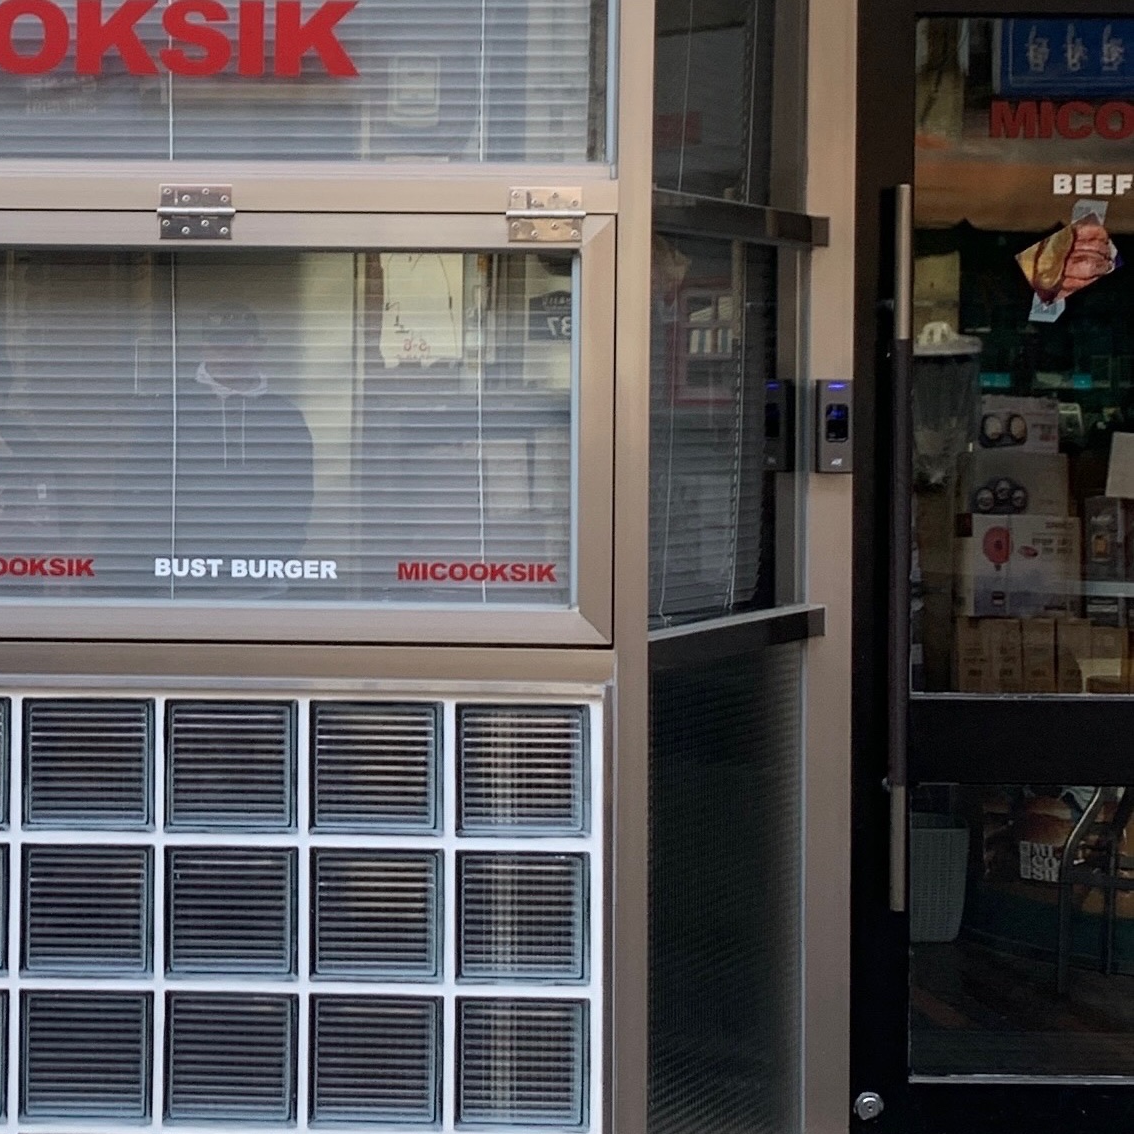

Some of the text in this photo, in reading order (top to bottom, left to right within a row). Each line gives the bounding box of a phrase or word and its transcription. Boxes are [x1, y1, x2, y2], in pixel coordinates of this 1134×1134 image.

[988, 100, 1134, 140] MICO
[1053, 173, 1134, 195] BEEF
[154, 558, 337, 579] BUST BURGER
[397, 562, 557, 583] MICOOKSIK
